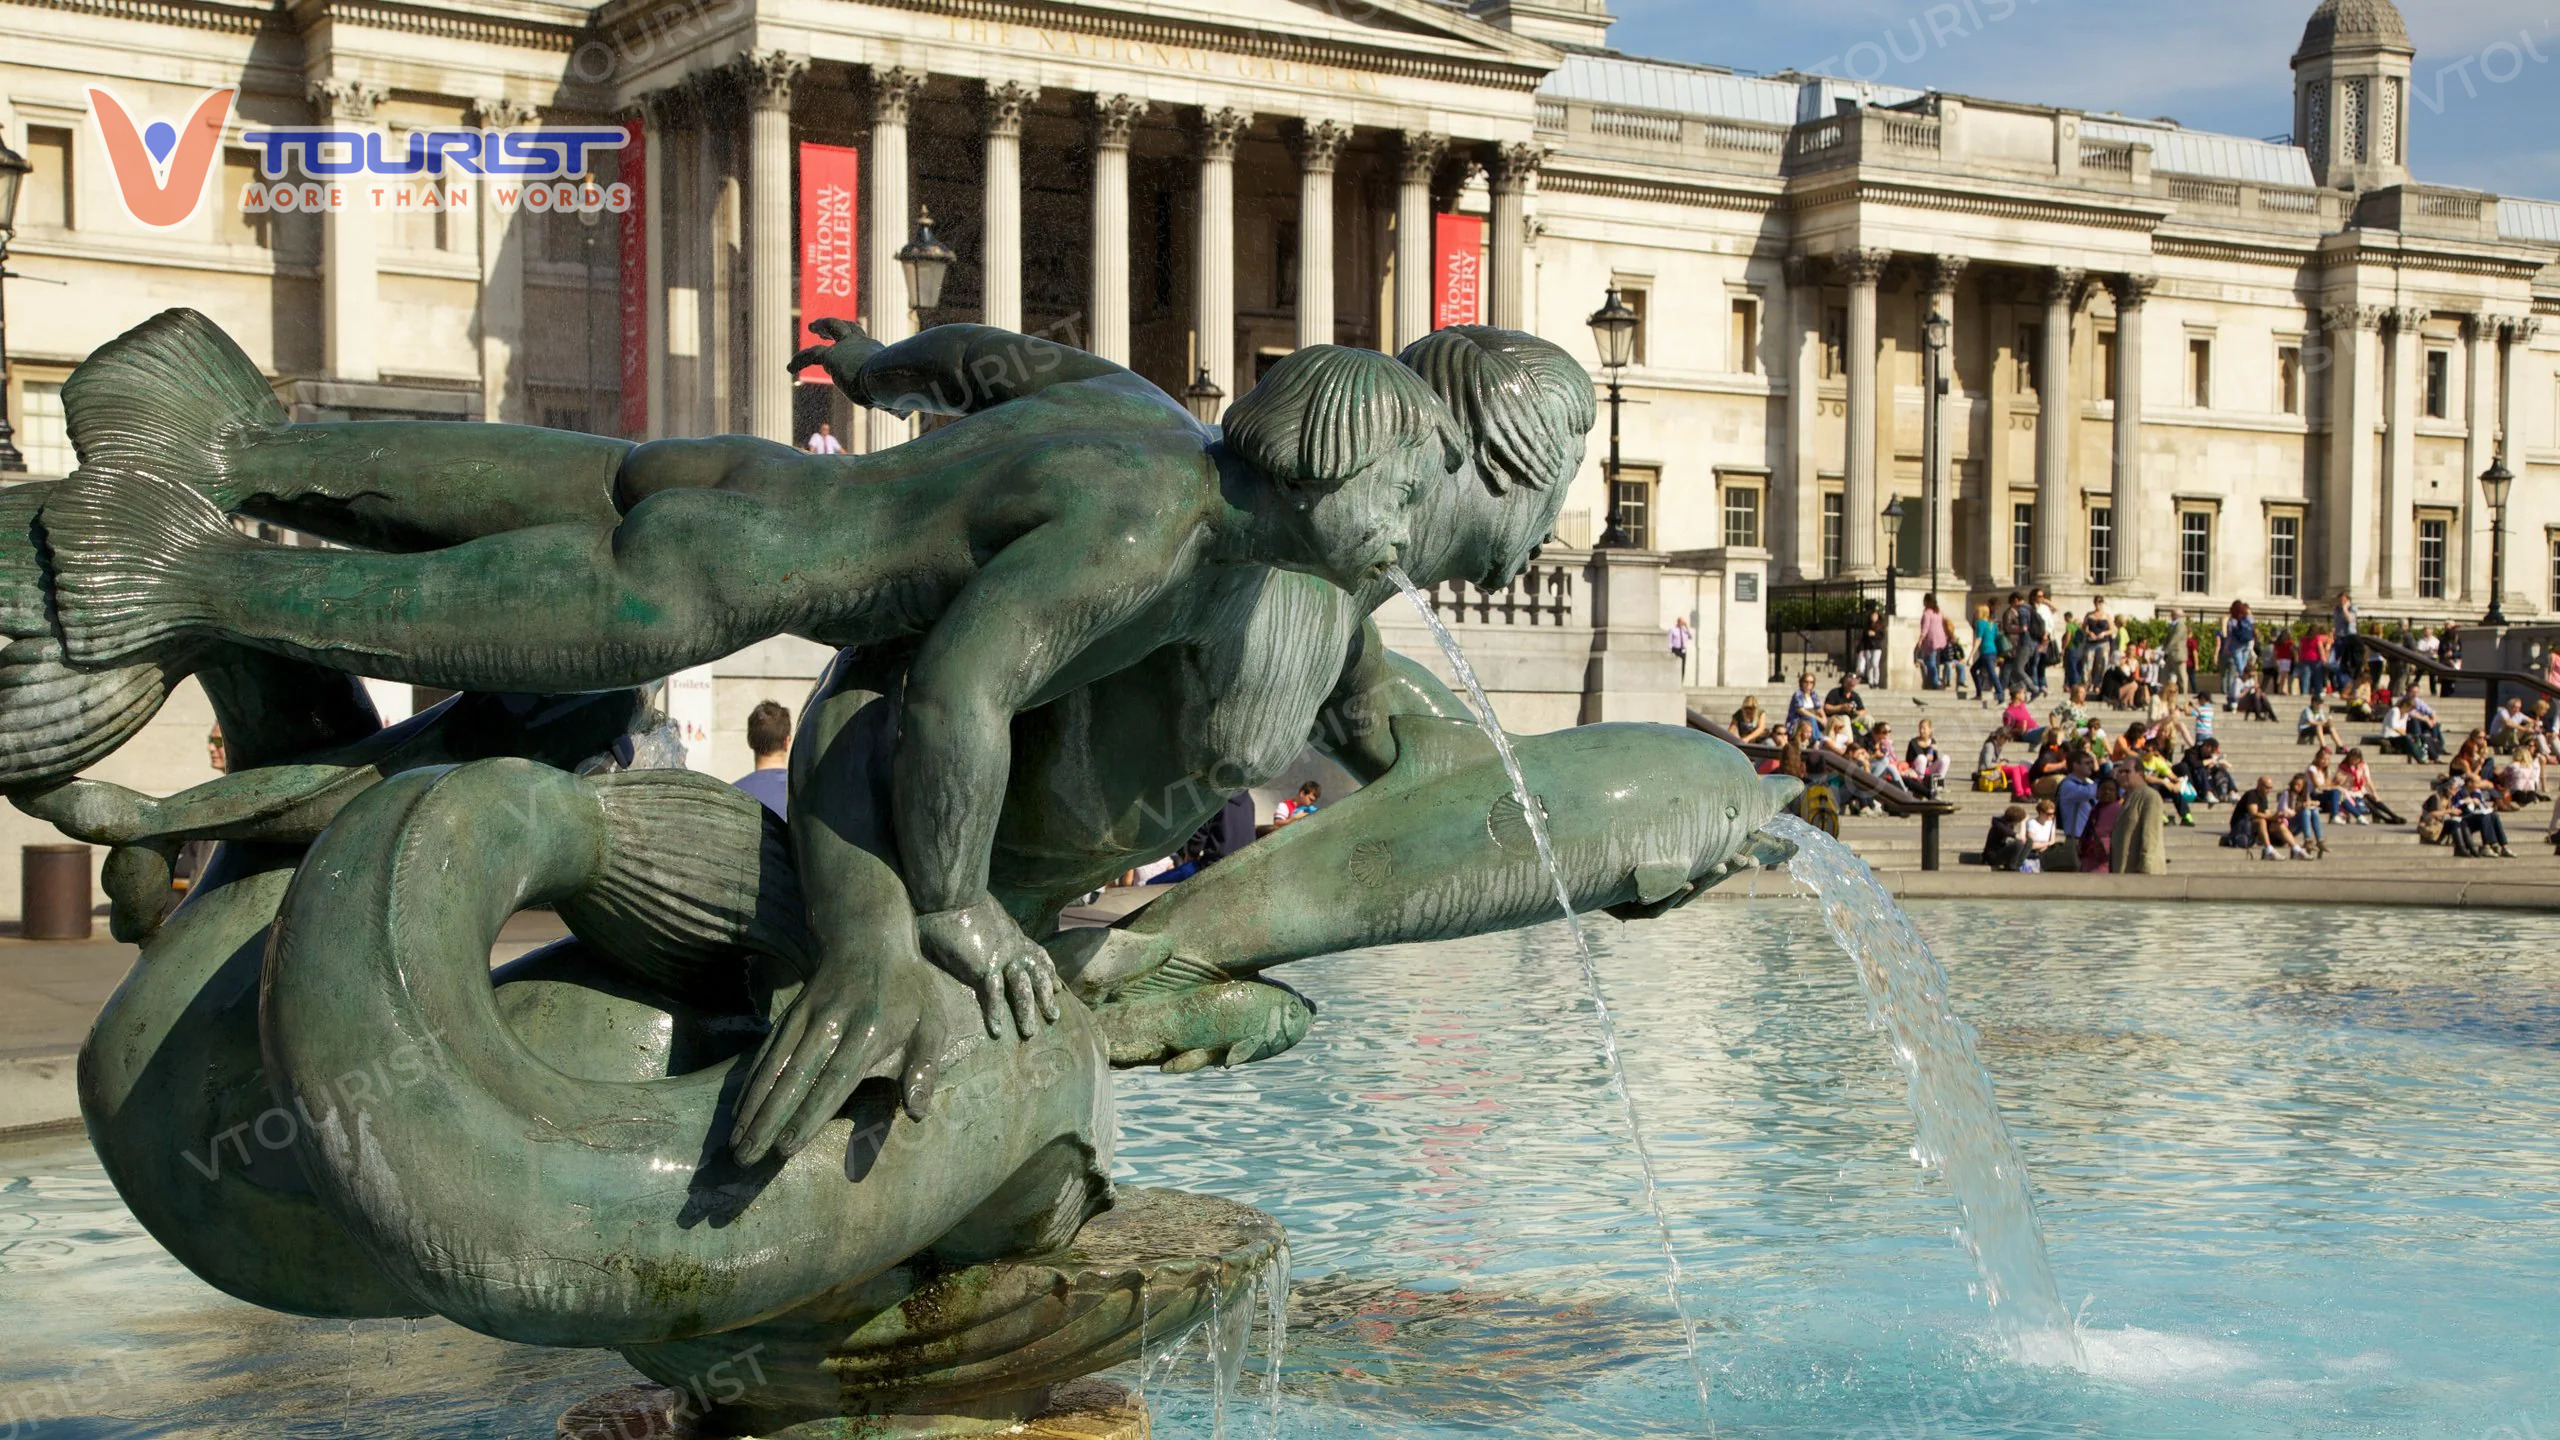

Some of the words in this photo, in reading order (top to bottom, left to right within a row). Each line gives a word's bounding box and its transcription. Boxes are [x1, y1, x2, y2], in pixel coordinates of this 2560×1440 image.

[945, 15, 1012, 48] THE
[1038, 28, 1213, 73] NATIONAL
[1237, 54, 1380, 95] GALLERY
[816, 183, 832, 295] NATIONAL
[832, 184, 851, 297] GALLERY
[1448, 249, 1460, 327] TIONAL
[1461, 249, 1476, 327] LLERY
[673, 679, 710, 689] Toilets
